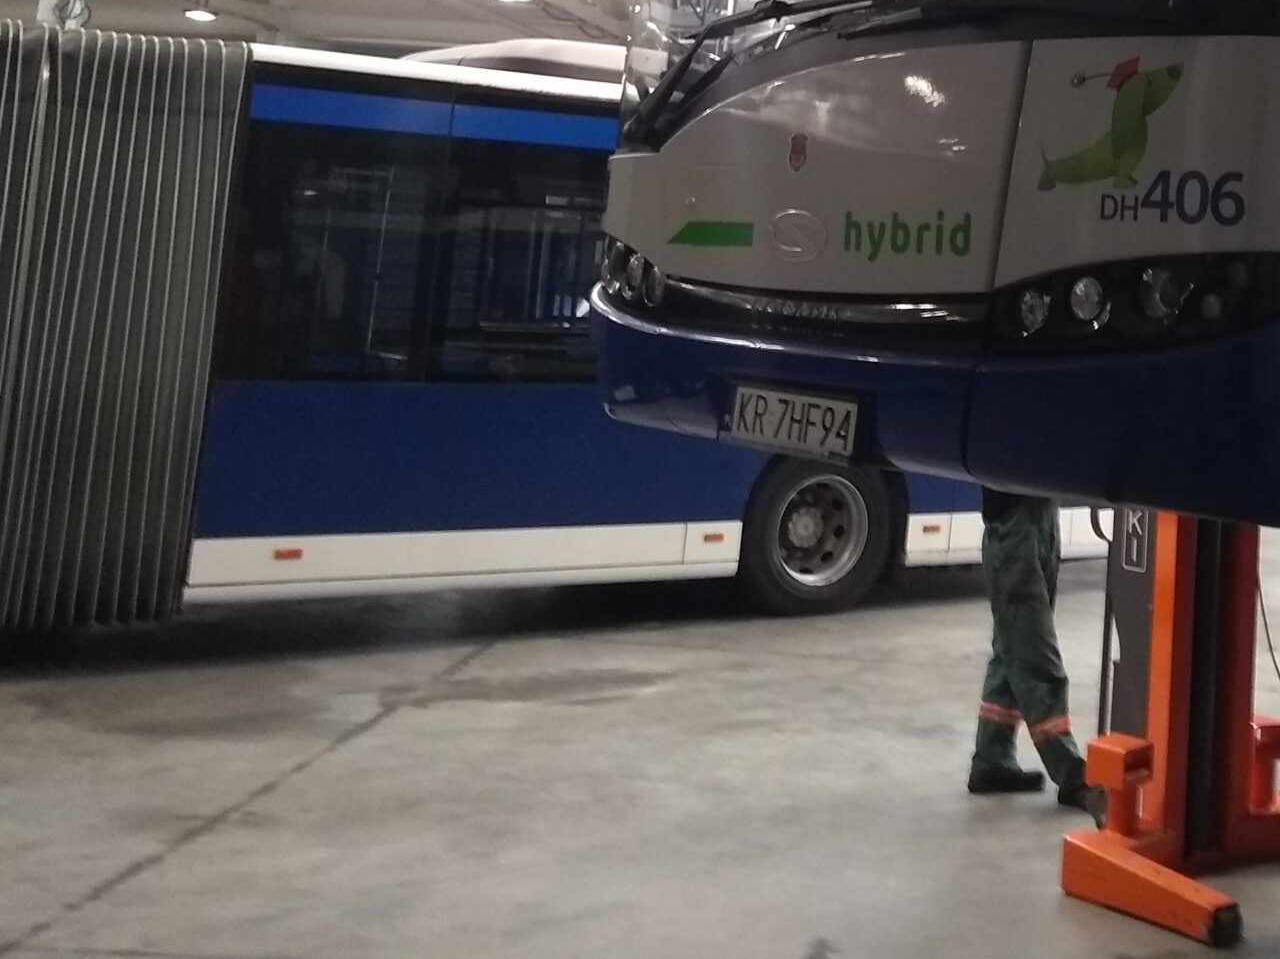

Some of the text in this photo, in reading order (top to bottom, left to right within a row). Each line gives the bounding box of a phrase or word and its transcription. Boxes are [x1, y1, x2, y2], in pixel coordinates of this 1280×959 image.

[844, 210, 972, 263] hybrid
[736, 392, 852, 451] KR 7HF94
